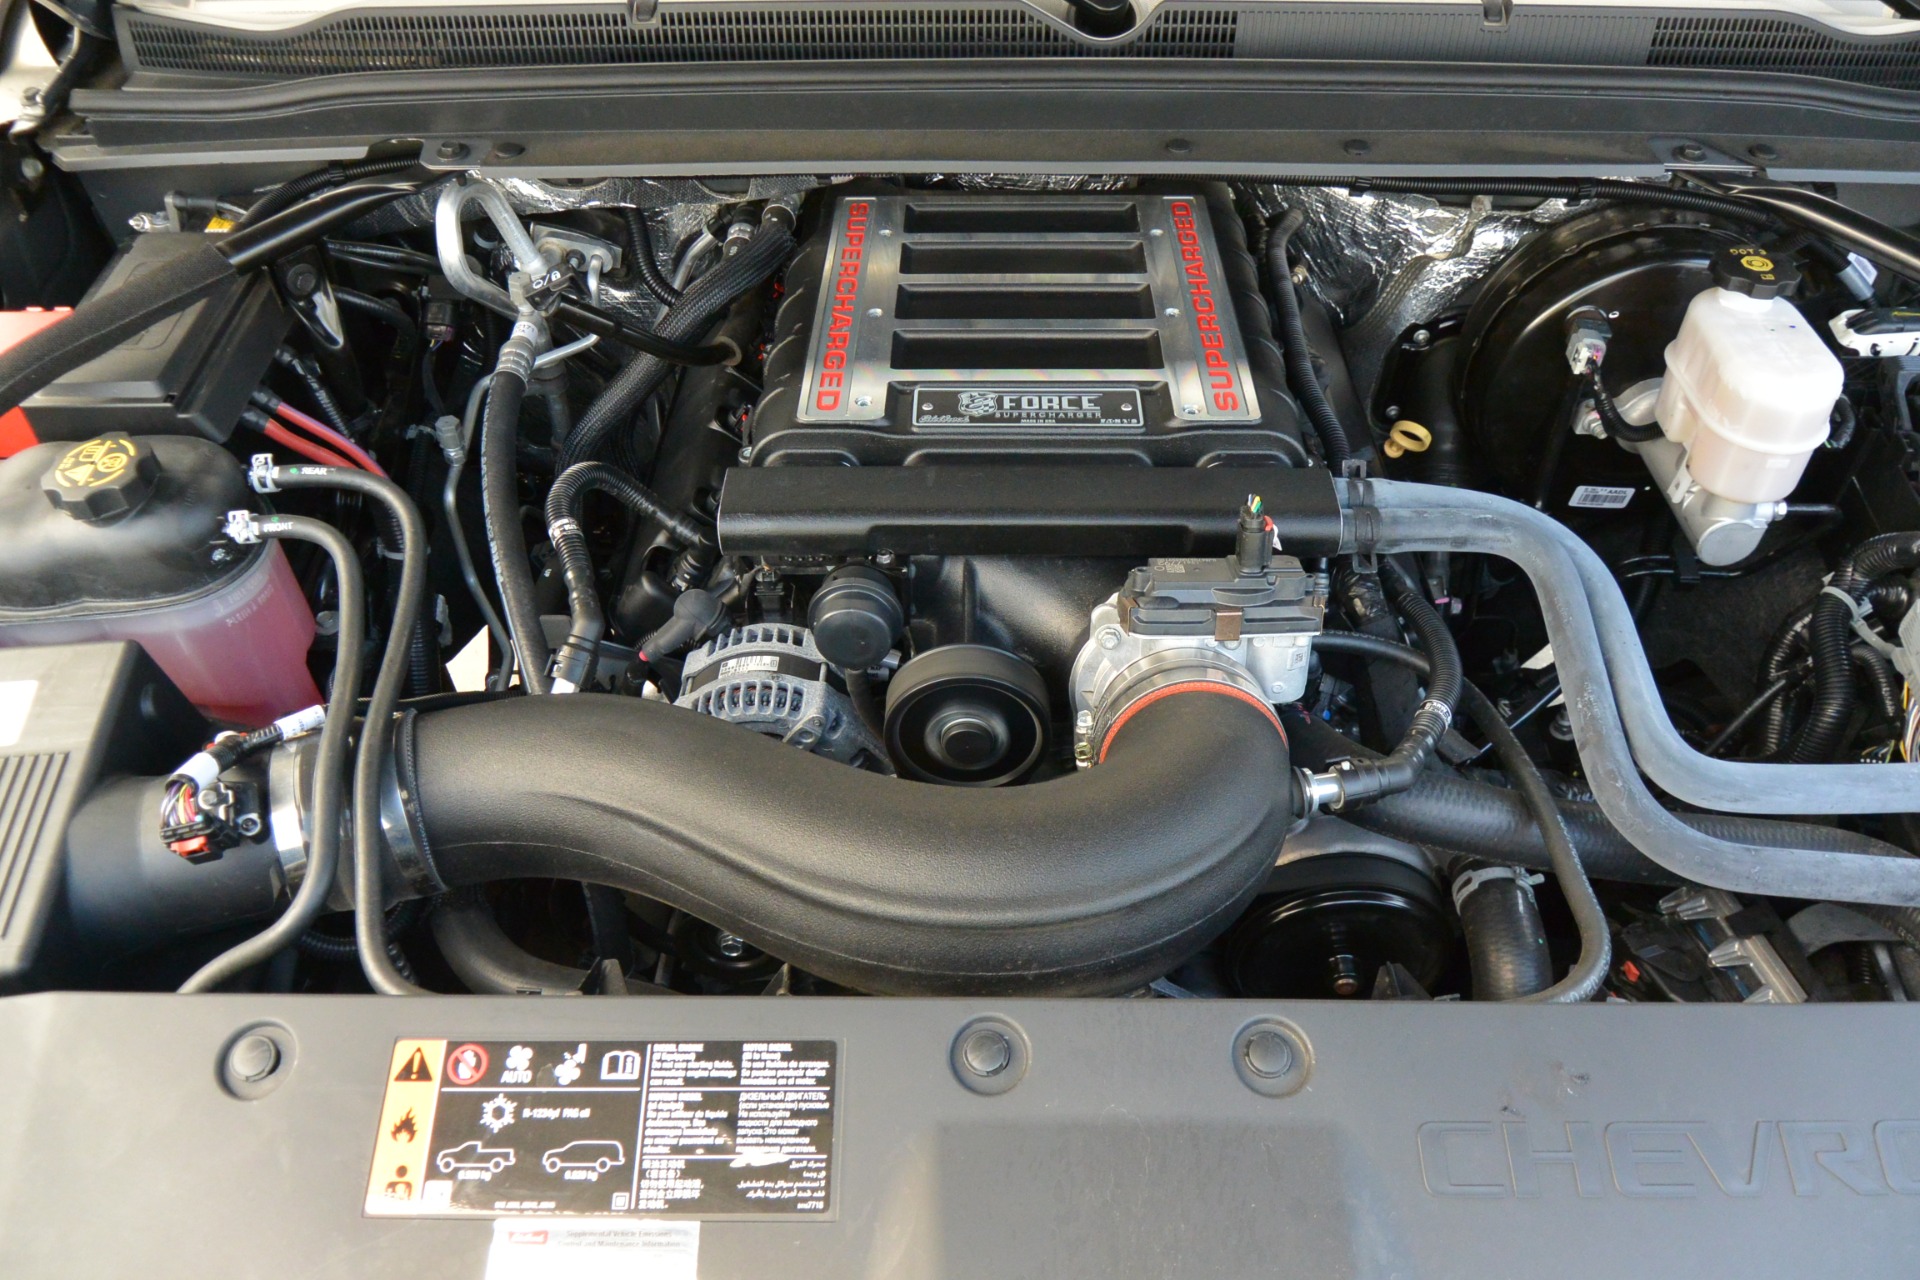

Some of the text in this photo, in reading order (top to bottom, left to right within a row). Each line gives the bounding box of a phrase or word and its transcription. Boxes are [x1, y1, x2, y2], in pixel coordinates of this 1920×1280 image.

[816, 202, 869, 411] SUPERCHARGED
[1170, 202, 1238, 411] SUPERCHARGED
[1002, 395, 1100, 410] FORCE
[994, 411, 1102, 419] SUPERCHARGER
[301, 467, 328, 475] REAR
[263, 521, 294, 533] FRONT
[500, 1069, 533, 1083] AUTO
[785, 1091, 827, 1101] ДВИГАТЕЛЬ
